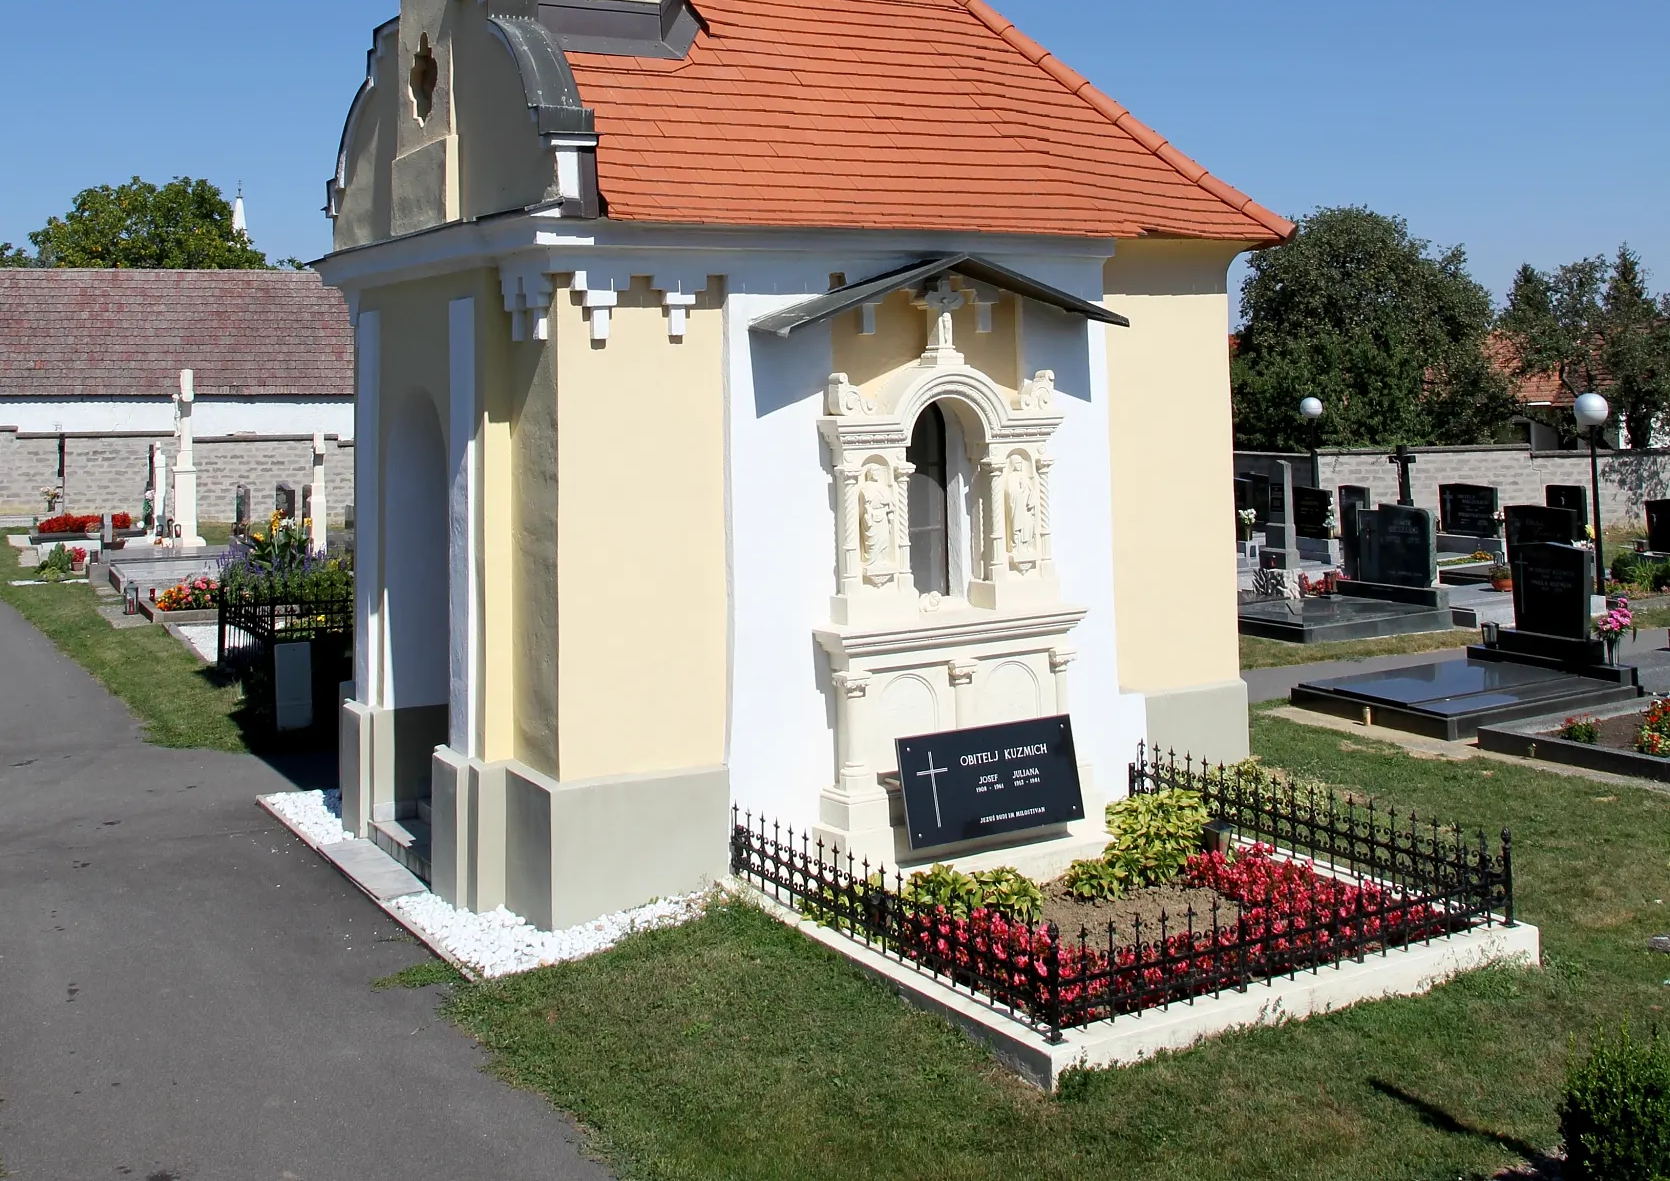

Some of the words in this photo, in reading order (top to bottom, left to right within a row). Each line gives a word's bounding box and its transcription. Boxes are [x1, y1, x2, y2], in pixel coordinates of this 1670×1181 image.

[960, 751, 999, 766] OBITELJ
[1004, 743, 1047, 760] KUZMICH
[979, 774, 998, 784] JOSEF
[1012, 768, 1040, 779] JULIANA
